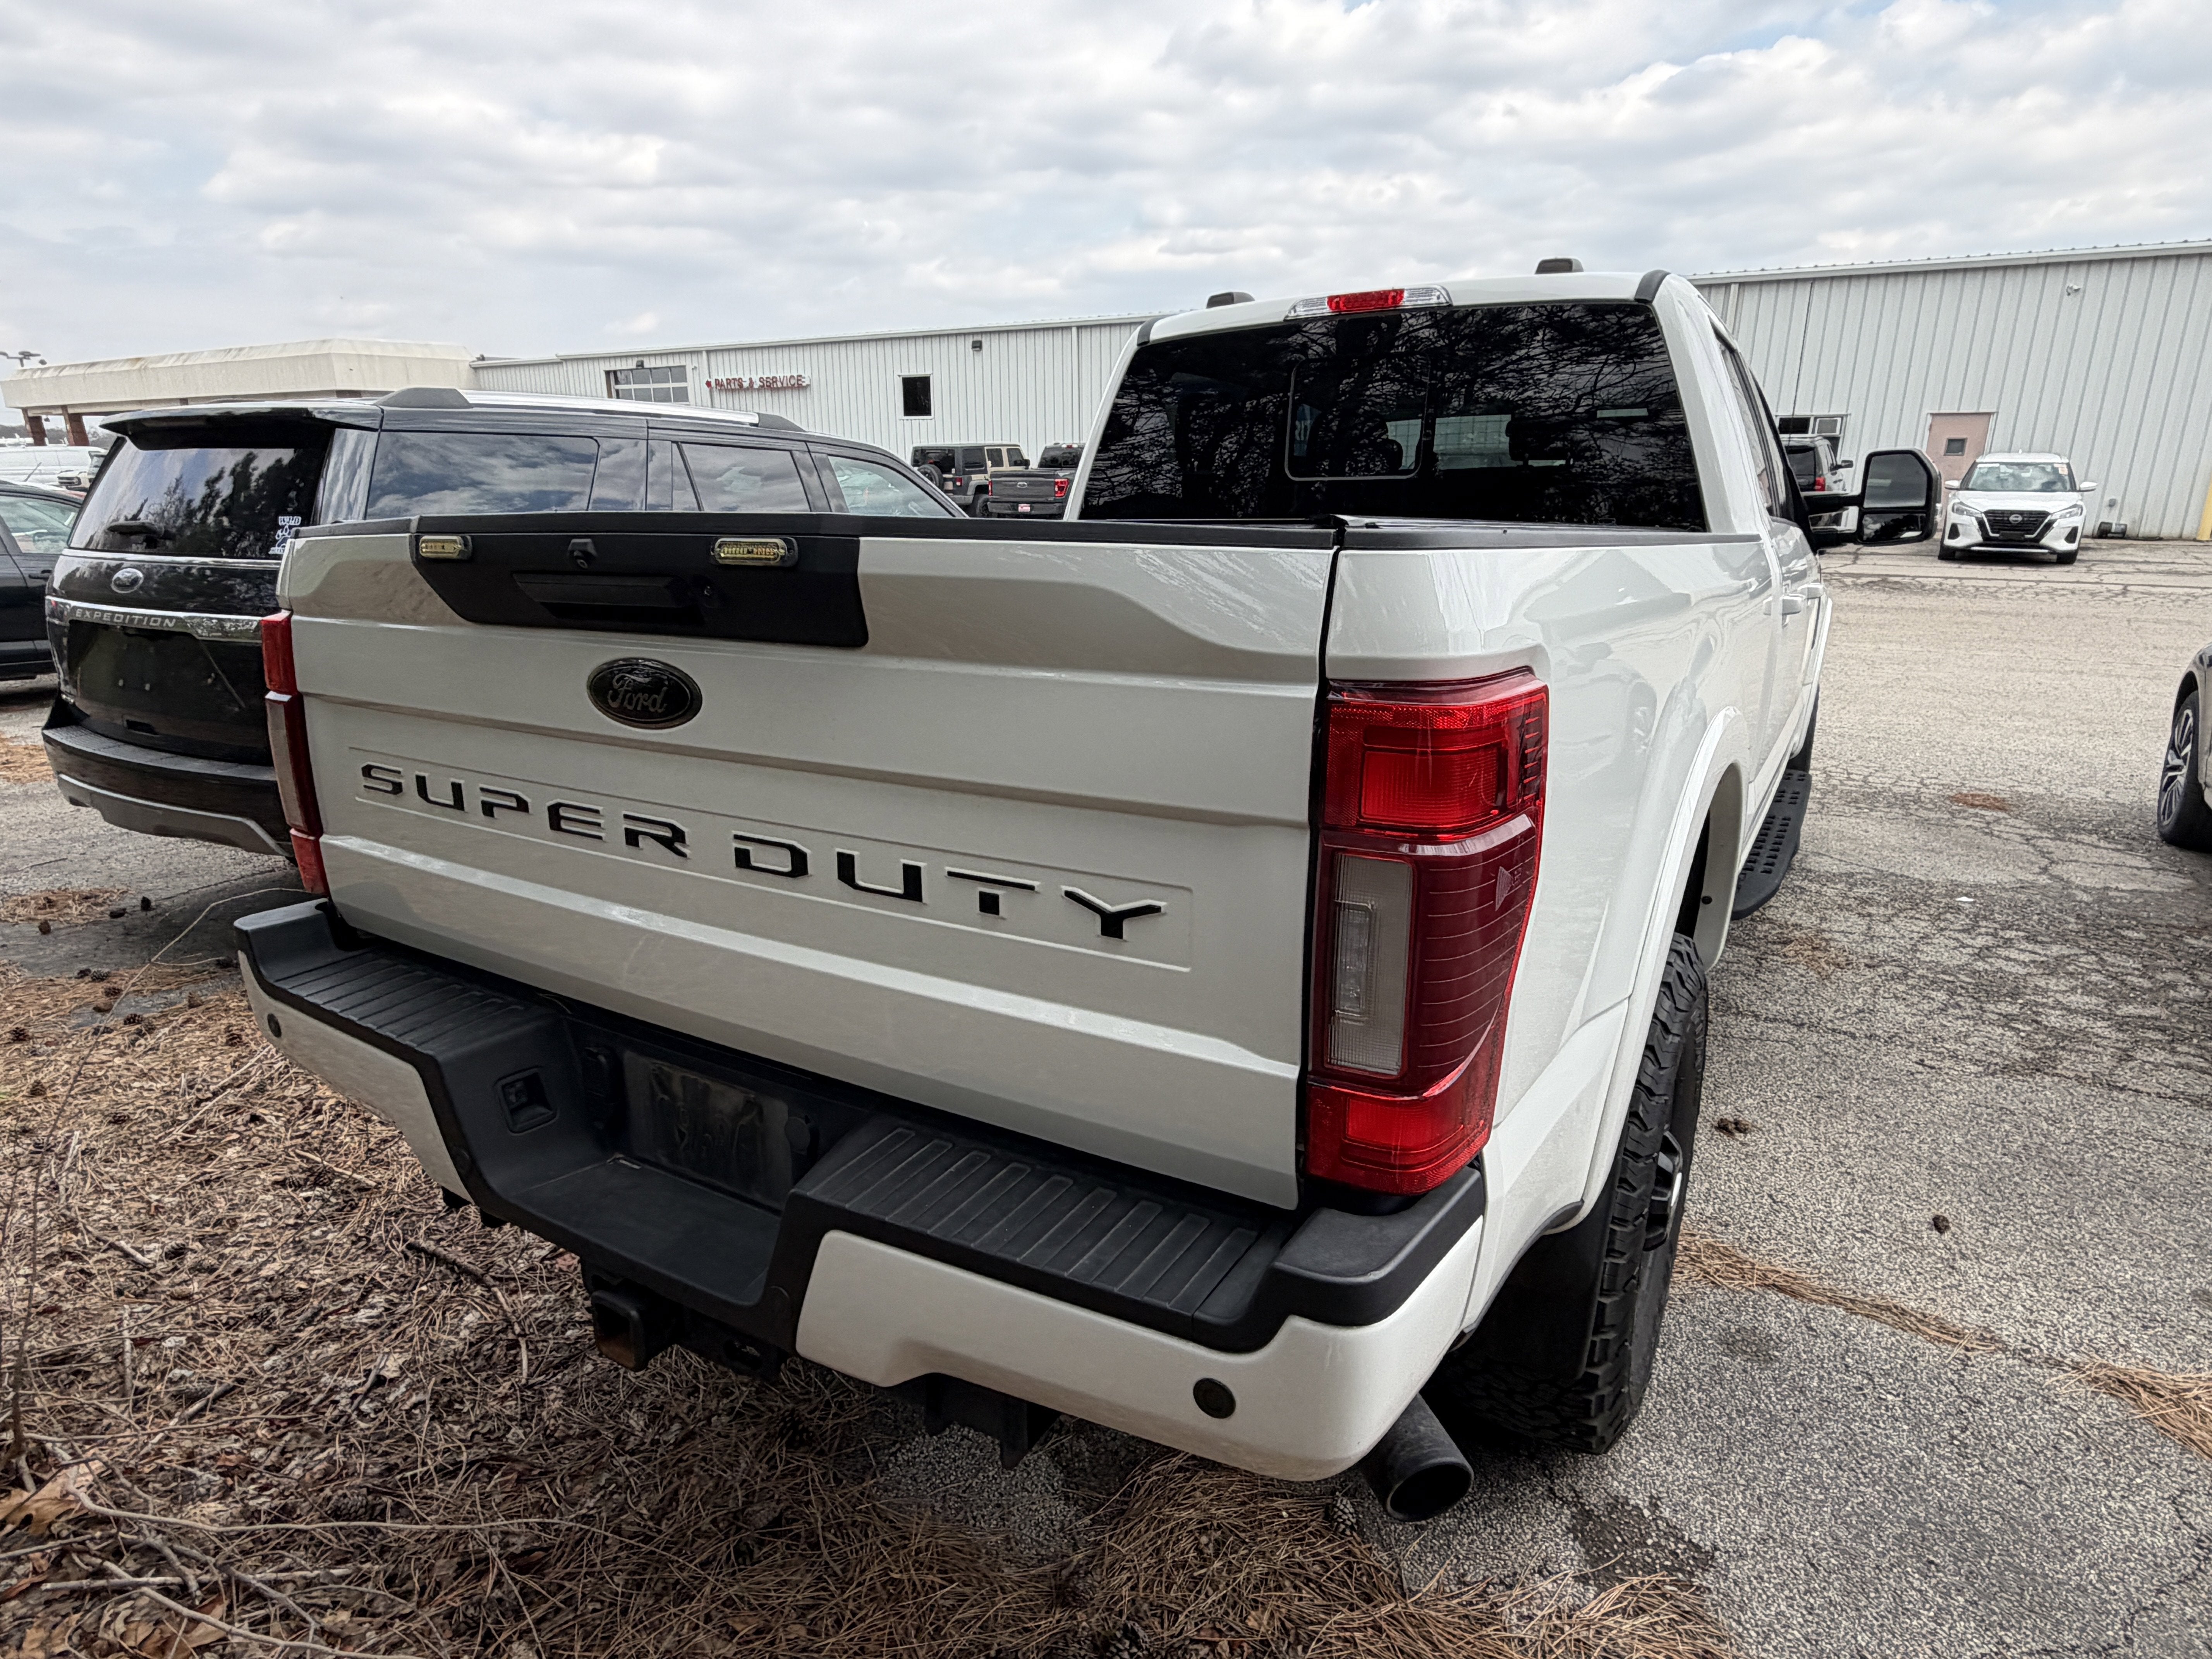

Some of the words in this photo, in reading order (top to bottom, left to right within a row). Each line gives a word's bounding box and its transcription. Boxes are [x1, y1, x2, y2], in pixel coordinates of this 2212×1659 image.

[715, 377, 744, 389] PARTS
[748, 377, 754, 388] &
[759, 374, 803, 388] SERVICE
[76, 609, 176, 627] EXPEDITION
[607, 673, 668, 713] Ford
[361, 762, 689, 858] SUPER
[732, 831, 1166, 939] DUTY
